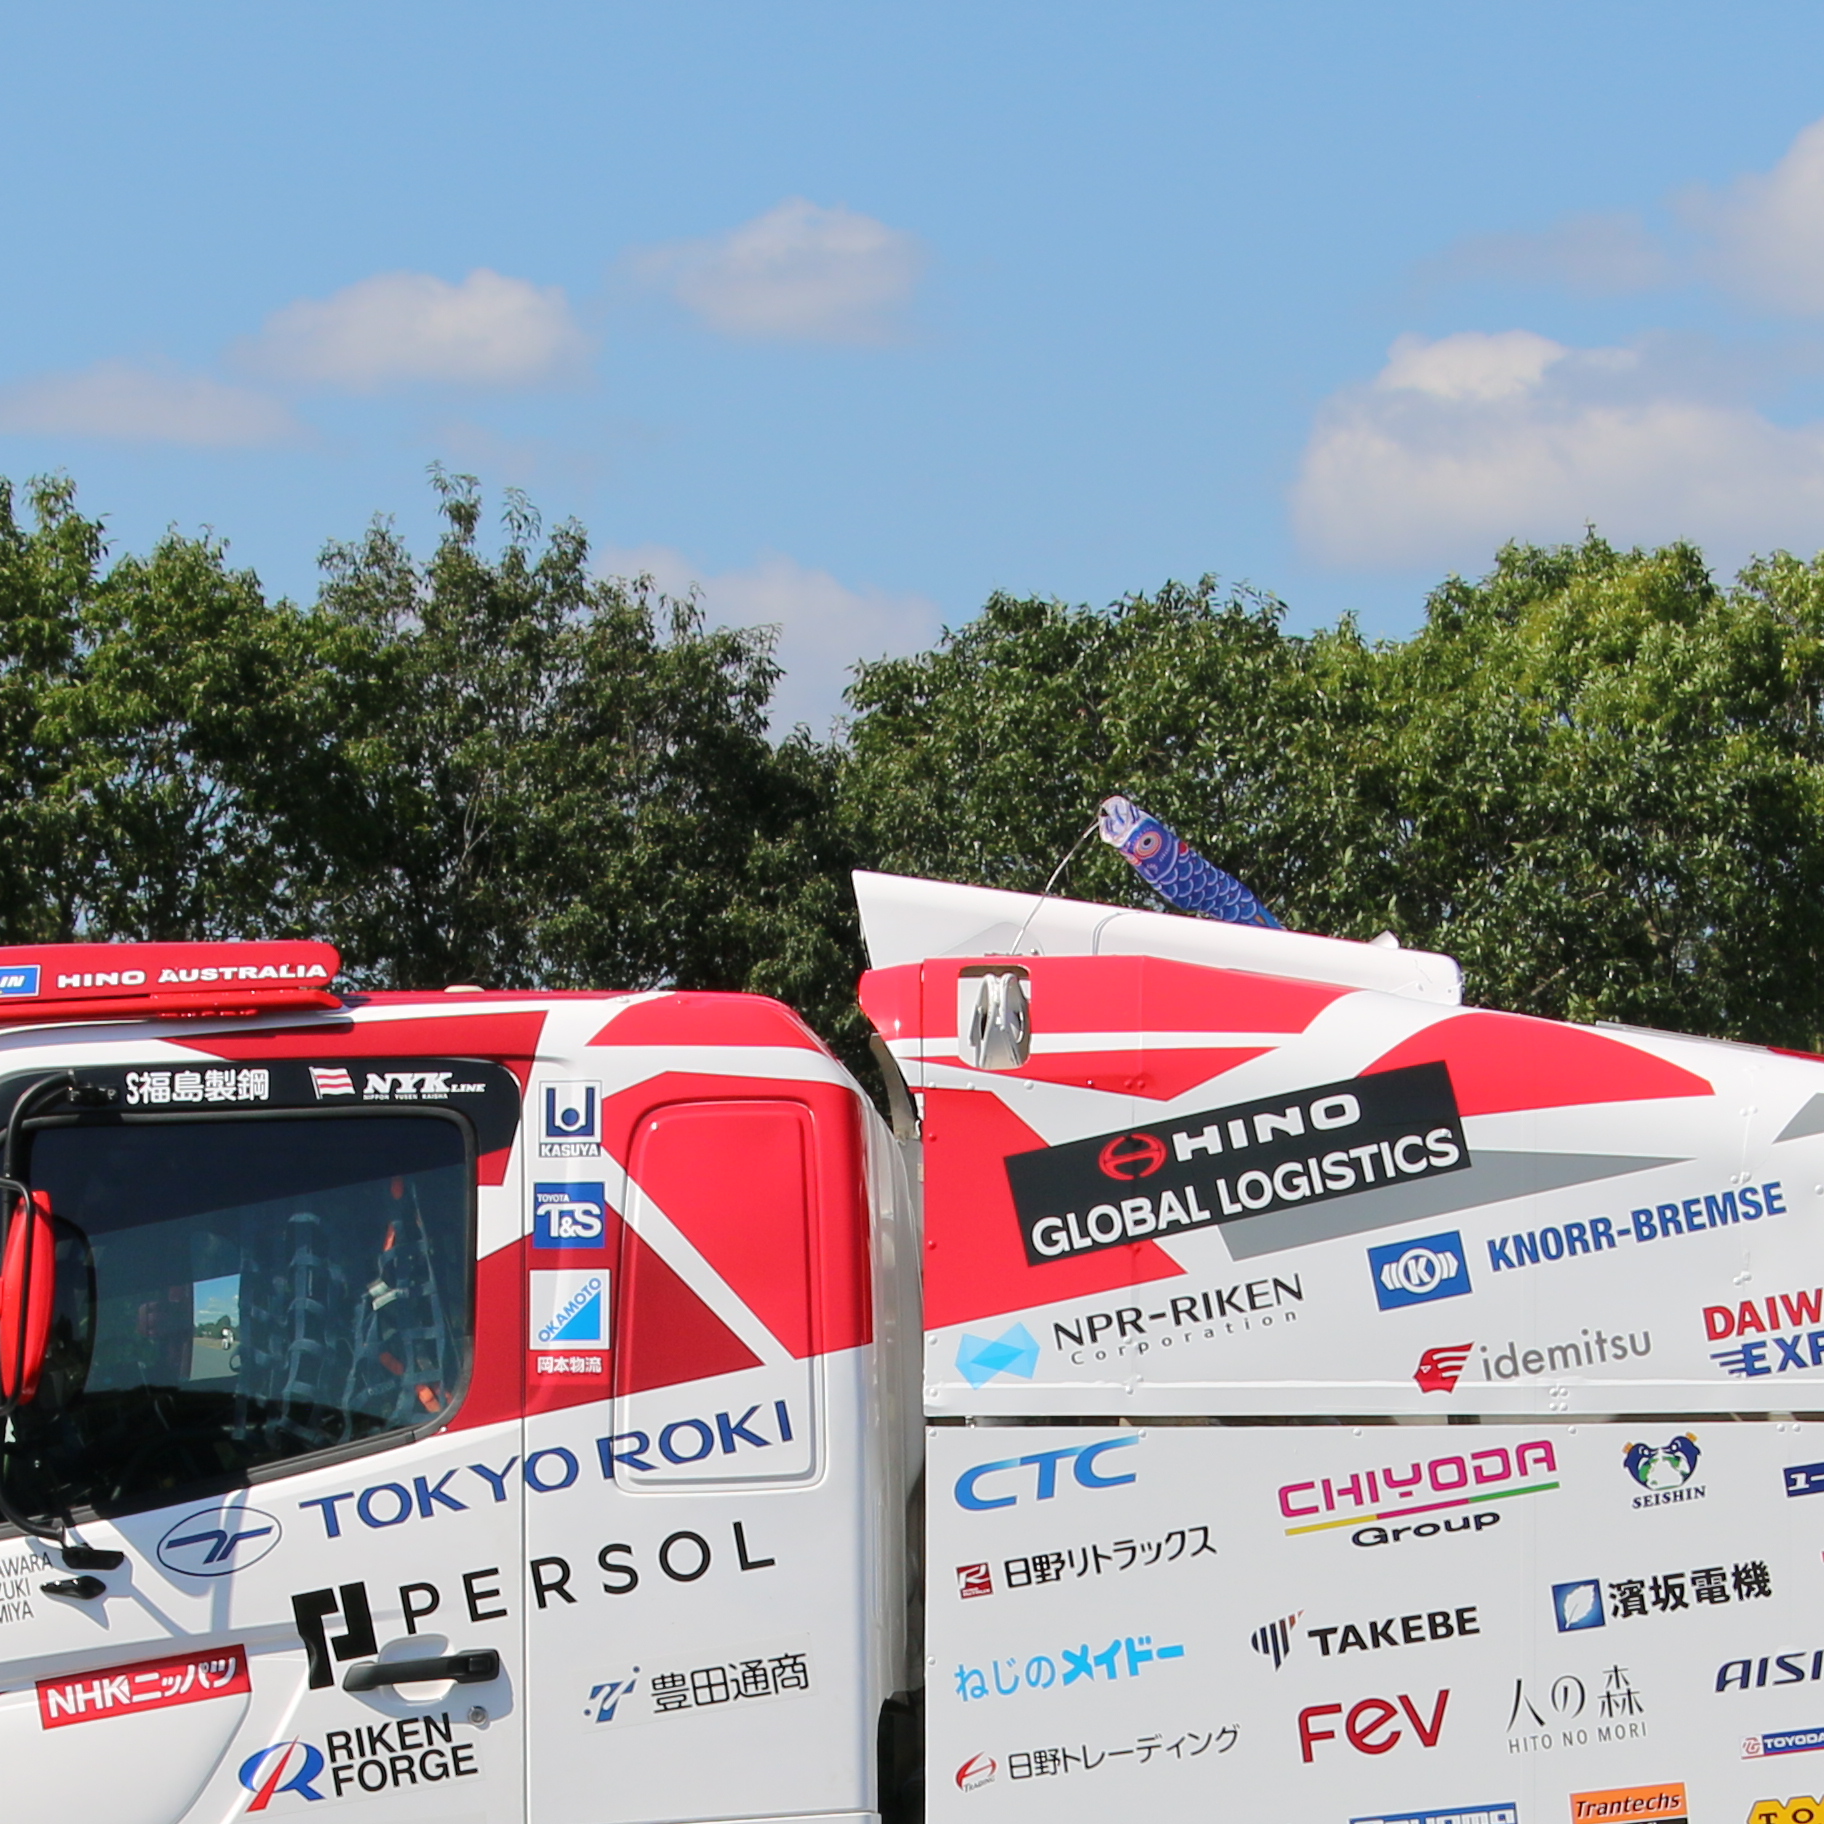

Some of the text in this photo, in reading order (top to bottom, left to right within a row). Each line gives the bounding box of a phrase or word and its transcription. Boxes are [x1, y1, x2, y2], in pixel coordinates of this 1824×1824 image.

[57, 964, 327, 989] HINO AUSTRALIA
[363, 1072, 486, 1093] NYK LINE
[541, 1143, 600, 1157] KASUYA
[1171, 1093, 1362, 1161] HINO
[536, 1202, 603, 1238] T&S
[537, 1193, 570, 1202] TOYOTA
[1030, 1127, 1461, 1258] GLOBAL LOGISTICS
[1487, 1181, 1787, 1272] KNORR-BREMSE
[538, 1277, 602, 1343] OKAMOTO
[1054, 1273, 1305, 1350] NPR-RIKEN
[1071, 1307, 1298, 1366] Corporation
[537, 1357, 602, 1373] 岡本物流
[1481, 1328, 1652, 1382] idemitsu
[300, 1400, 794, 1538] TOKYO ROKI
[954, 1435, 1139, 1511] CTC
[1279, 1440, 1556, 1517] CHIYODA
[1632, 1486, 1706, 1509] SEISHIN
[1004, 1526, 1217, 1589] 日野リトラックス
[1352, 1512, 1500, 1546] Group
[400, 1521, 775, 1634] PERSOL
[1610, 1561, 1772, 1619] 濱坂電機
[1308, 1606, 1480, 1656] TAKEBE
[651, 1652, 810, 1715] 豊田通商
[954, 1636, 1184, 1701] ねじのメイドー
[1506, 1665, 1645, 1733] 人の森
[326, 1713, 453, 1763] RIKEN
[1008, 1723, 1240, 1780] 日野トレーディング
[1508, 1722, 1647, 1753] HITO NO MORI
[331, 1744, 479, 1797] FORGE
[1576, 1793, 1681, 1819] Trantechs
